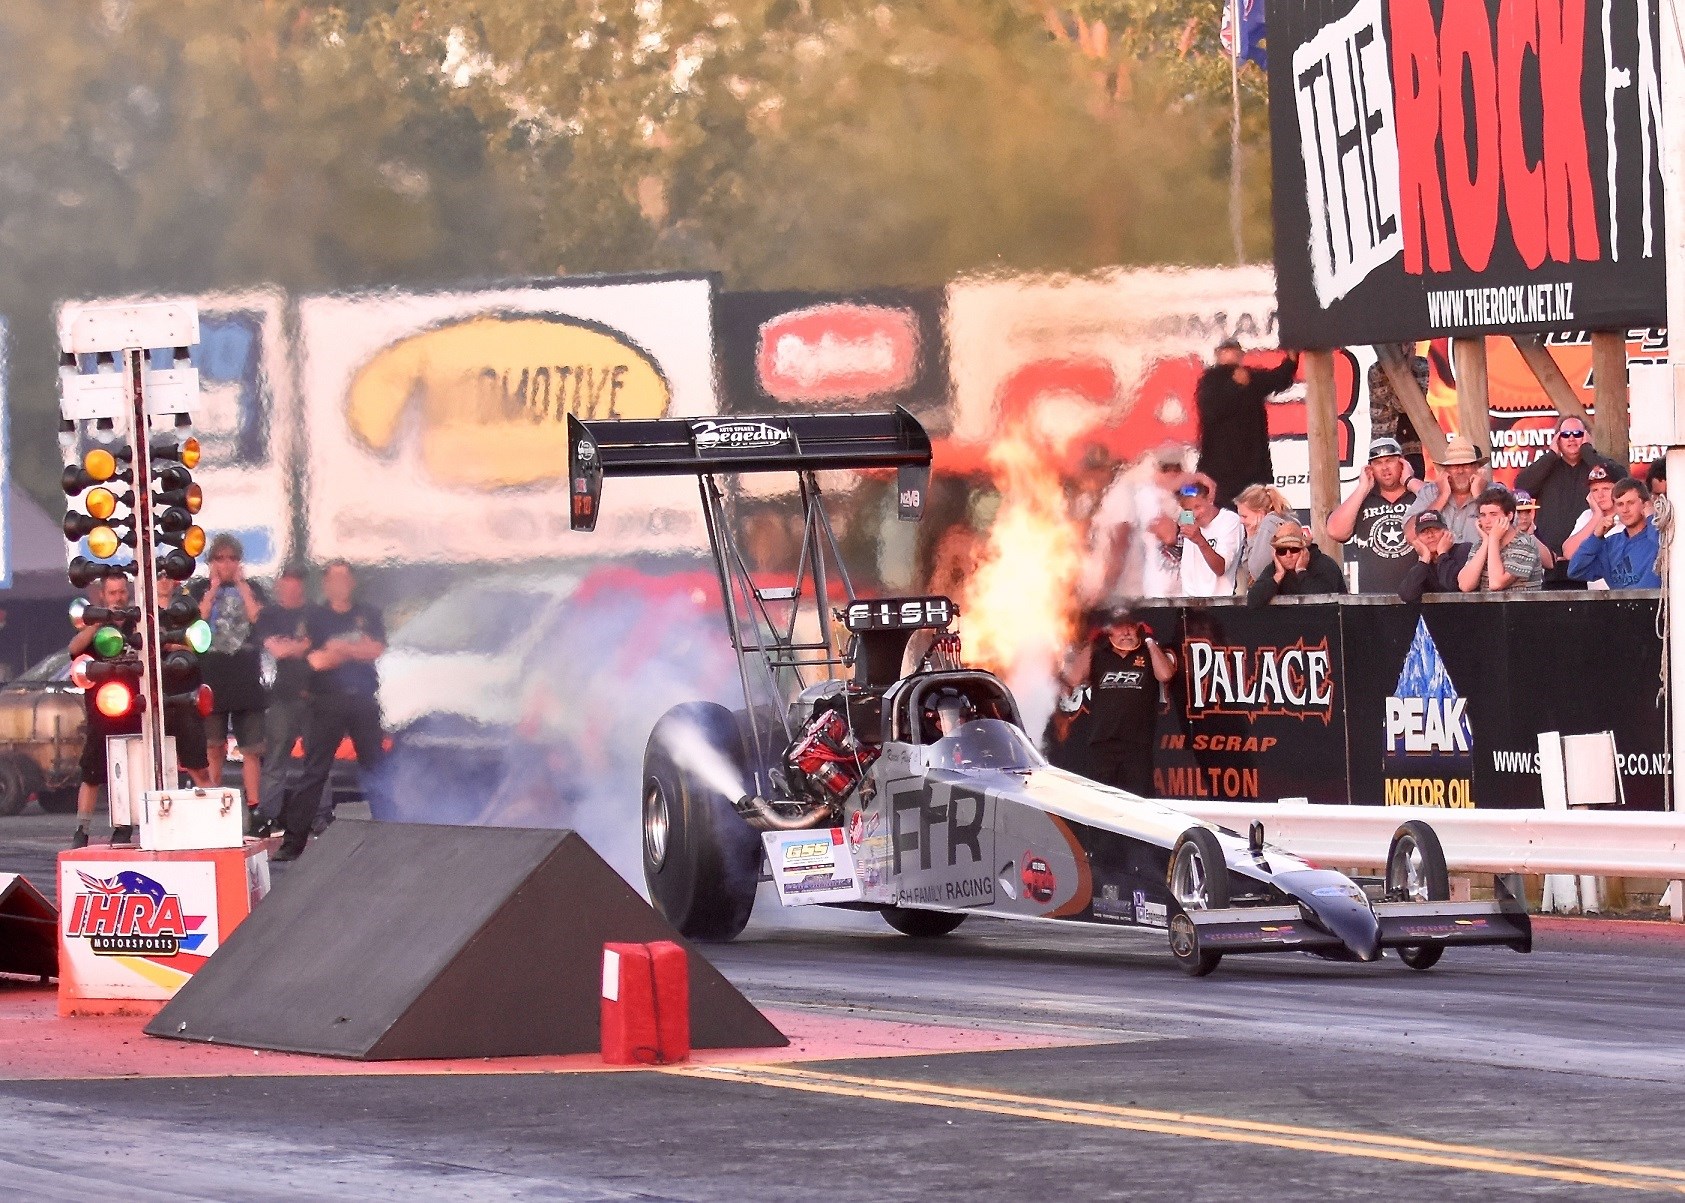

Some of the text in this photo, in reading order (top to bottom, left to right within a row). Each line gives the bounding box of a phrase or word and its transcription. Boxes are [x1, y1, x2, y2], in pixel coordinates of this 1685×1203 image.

[1297, 20, 1398, 278] THE
[1387, 0, 1601, 276] ROCK
[1427, 282, 1574, 328] WWW.THEROCK.NET.NZ
[849, 601, 948, 627] FISH
[1189, 642, 1332, 708] PALACE
[1385, 696, 1469, 752] PEAK
[1160, 734, 1278, 753] IN SCRAP
[1153, 766, 1259, 798] AMILTON
[1385, 778, 1476, 809] MOTOR OIL
[892, 778, 986, 876] FFR
[914, 883, 942, 903] FAMILY
[945, 876, 993, 900] RACING
[66, 893, 188, 938] IHRA
[93, 937, 174, 950] MOTORSPORTS
